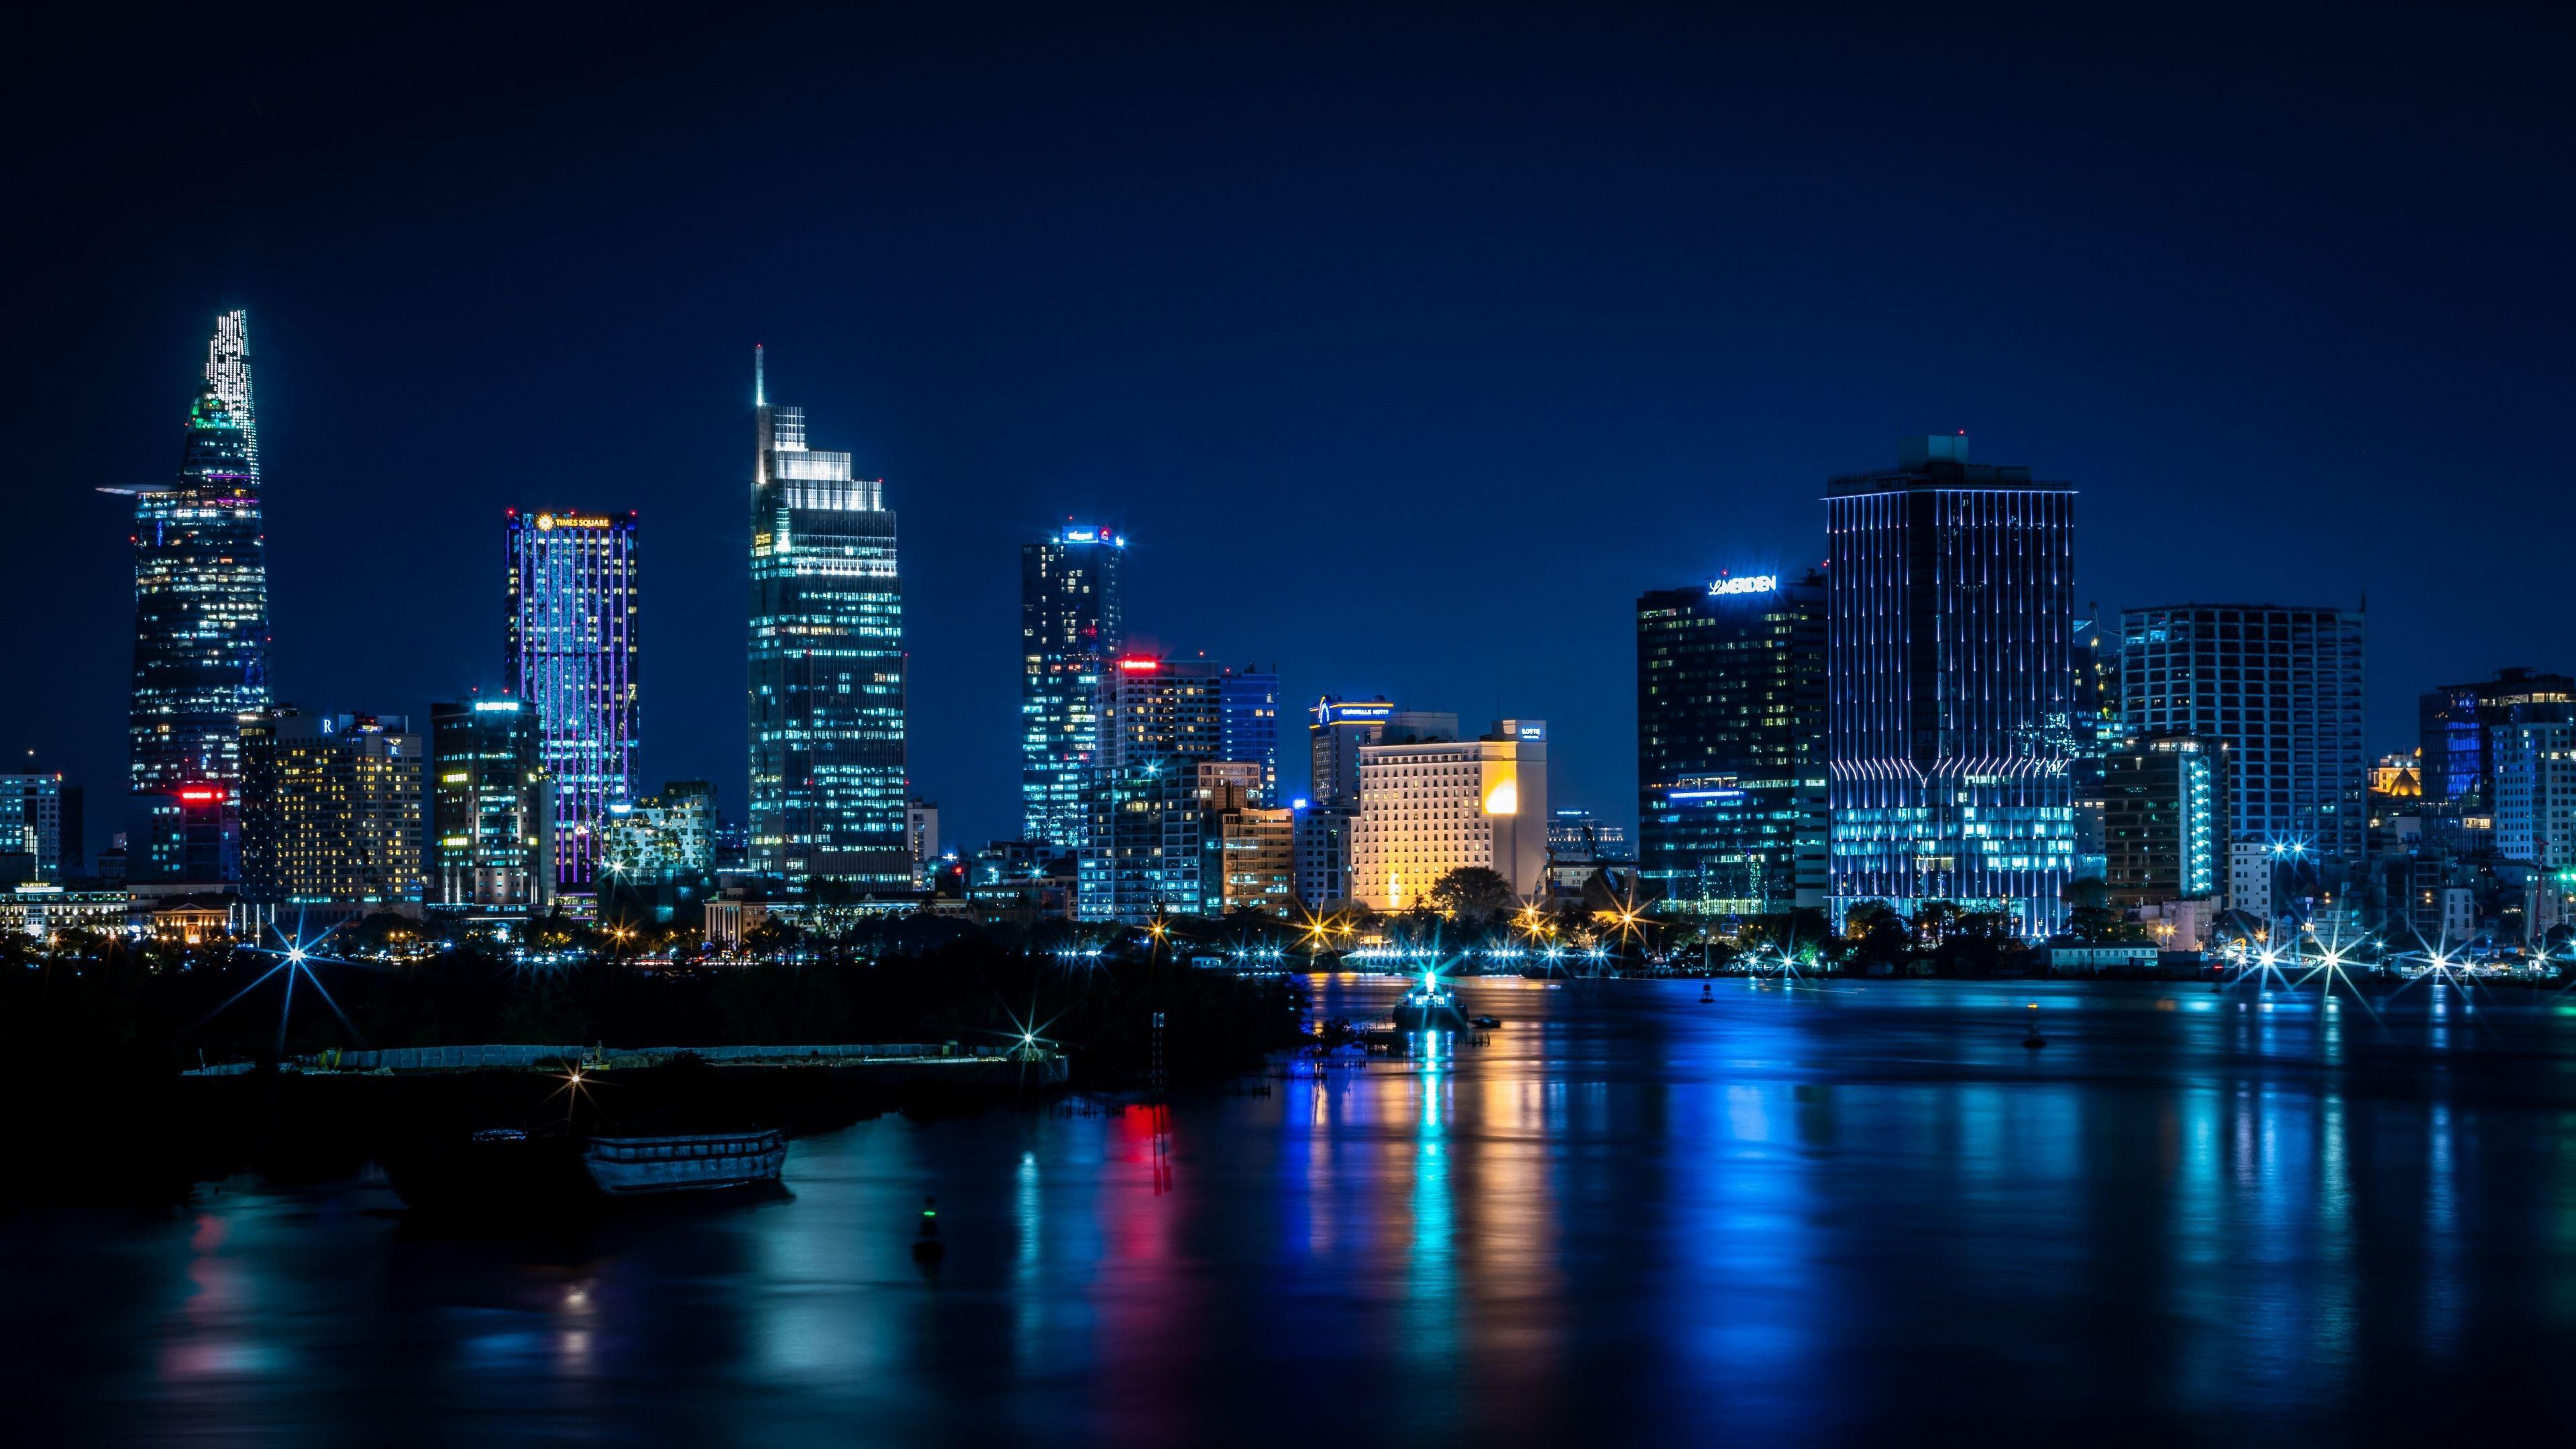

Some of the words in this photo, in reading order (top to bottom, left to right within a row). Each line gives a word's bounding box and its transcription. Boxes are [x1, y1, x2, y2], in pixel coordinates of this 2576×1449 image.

[555, 519, 578, 527] TIMES
[578, 519, 609, 527] SQUARE
[323, 719, 333, 733] R
[391, 746, 398, 755] R
